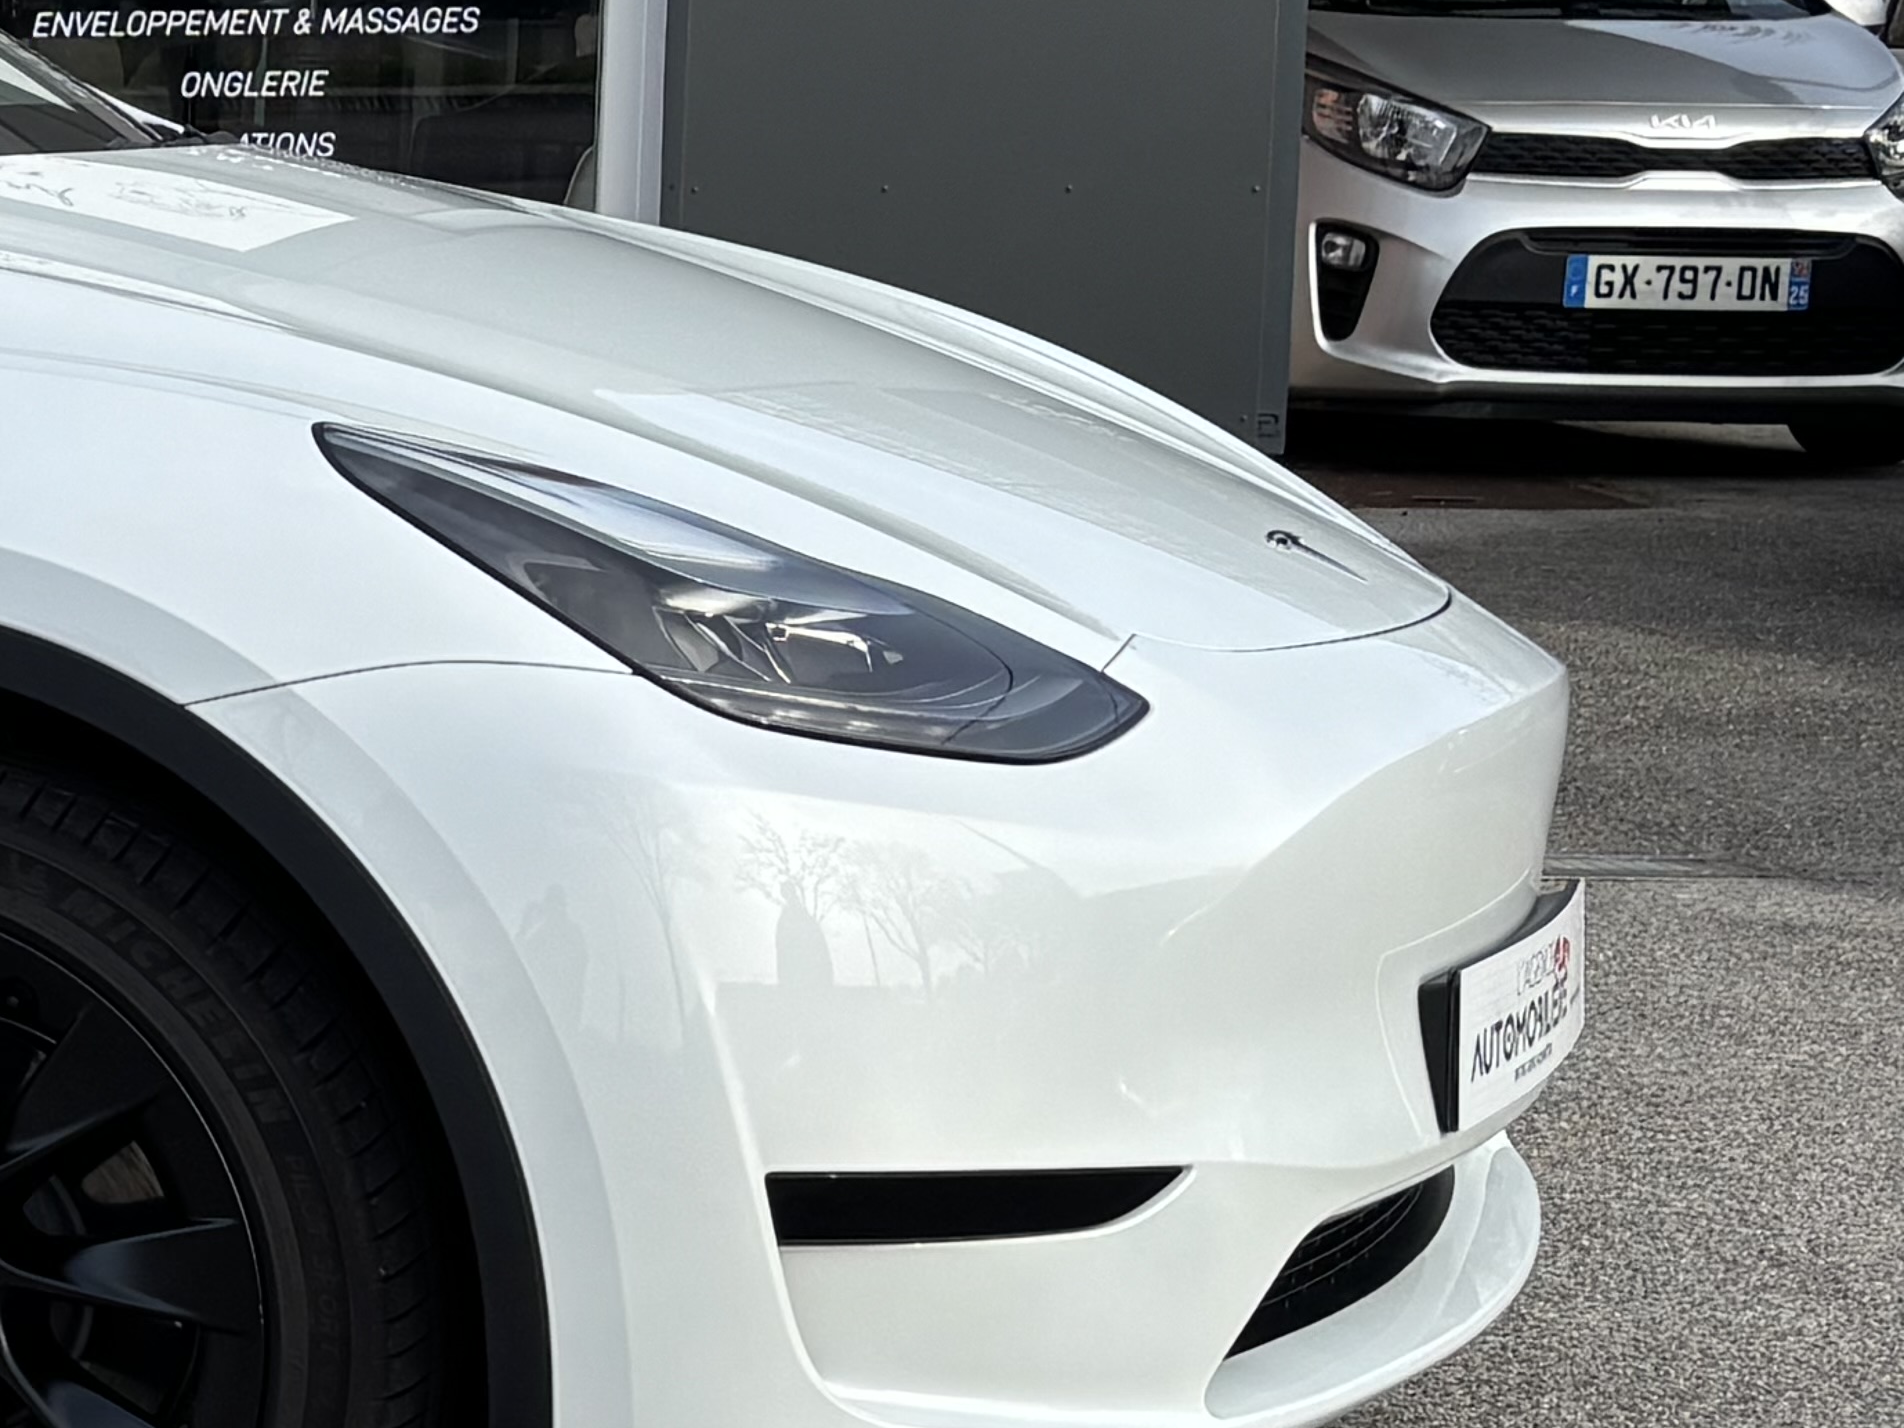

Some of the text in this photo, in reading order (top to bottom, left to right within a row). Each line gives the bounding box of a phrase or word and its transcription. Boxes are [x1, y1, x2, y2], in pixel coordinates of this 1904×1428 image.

[32, 6, 481, 38] ENVELOPPEMENT & MASSAGES
[180, 69, 330, 98] ONGLERIE
[1789, 285, 1809, 305] 25
